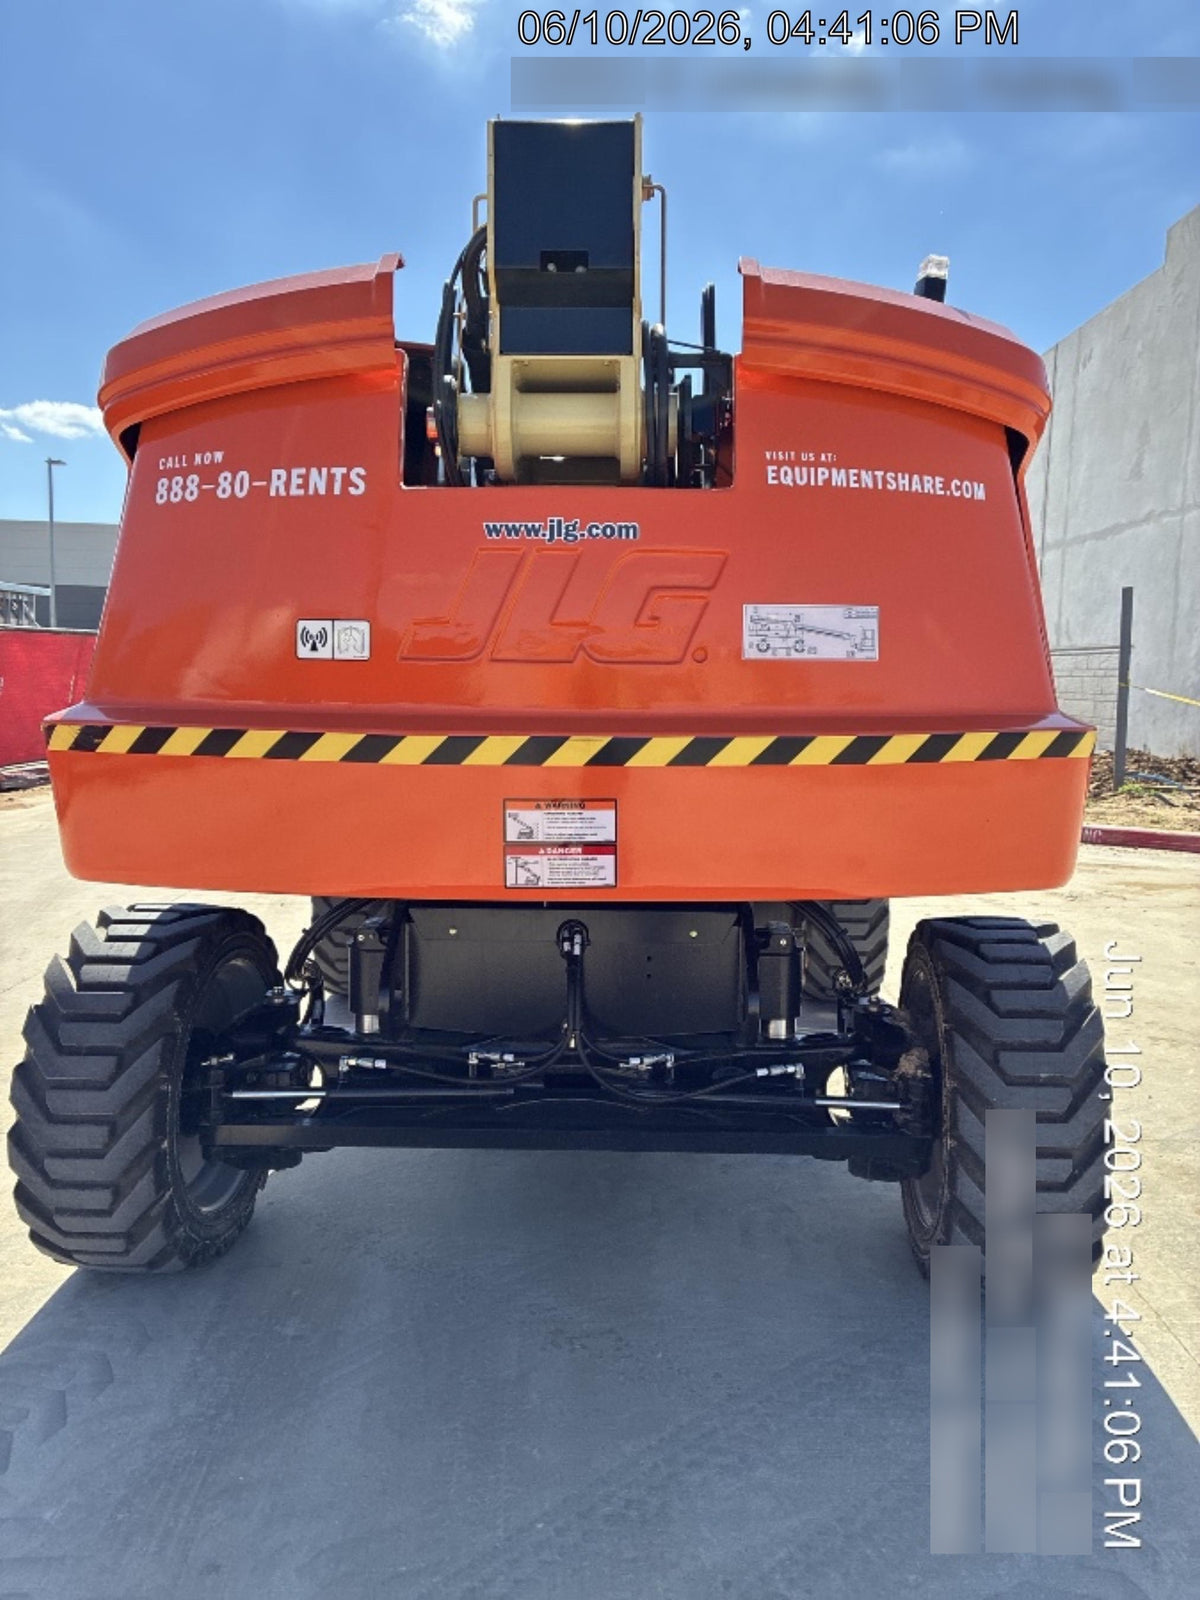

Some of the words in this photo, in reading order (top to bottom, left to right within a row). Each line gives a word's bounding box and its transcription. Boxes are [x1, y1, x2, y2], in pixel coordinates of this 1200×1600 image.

[159, 454, 188, 470] CALL
[194, 451, 225, 466] NOW
[765, 450, 796, 461] VISIT
[801, 452, 815, 461] US
[820, 453, 837, 462] AT:
[155, 466, 367, 505] 888-80-RENTS
[766, 465, 987, 500] EQUIPMENTSHARE.COM
[482, 518, 640, 543] www.jlg.com
[546, 847, 582, 855] DANGER
